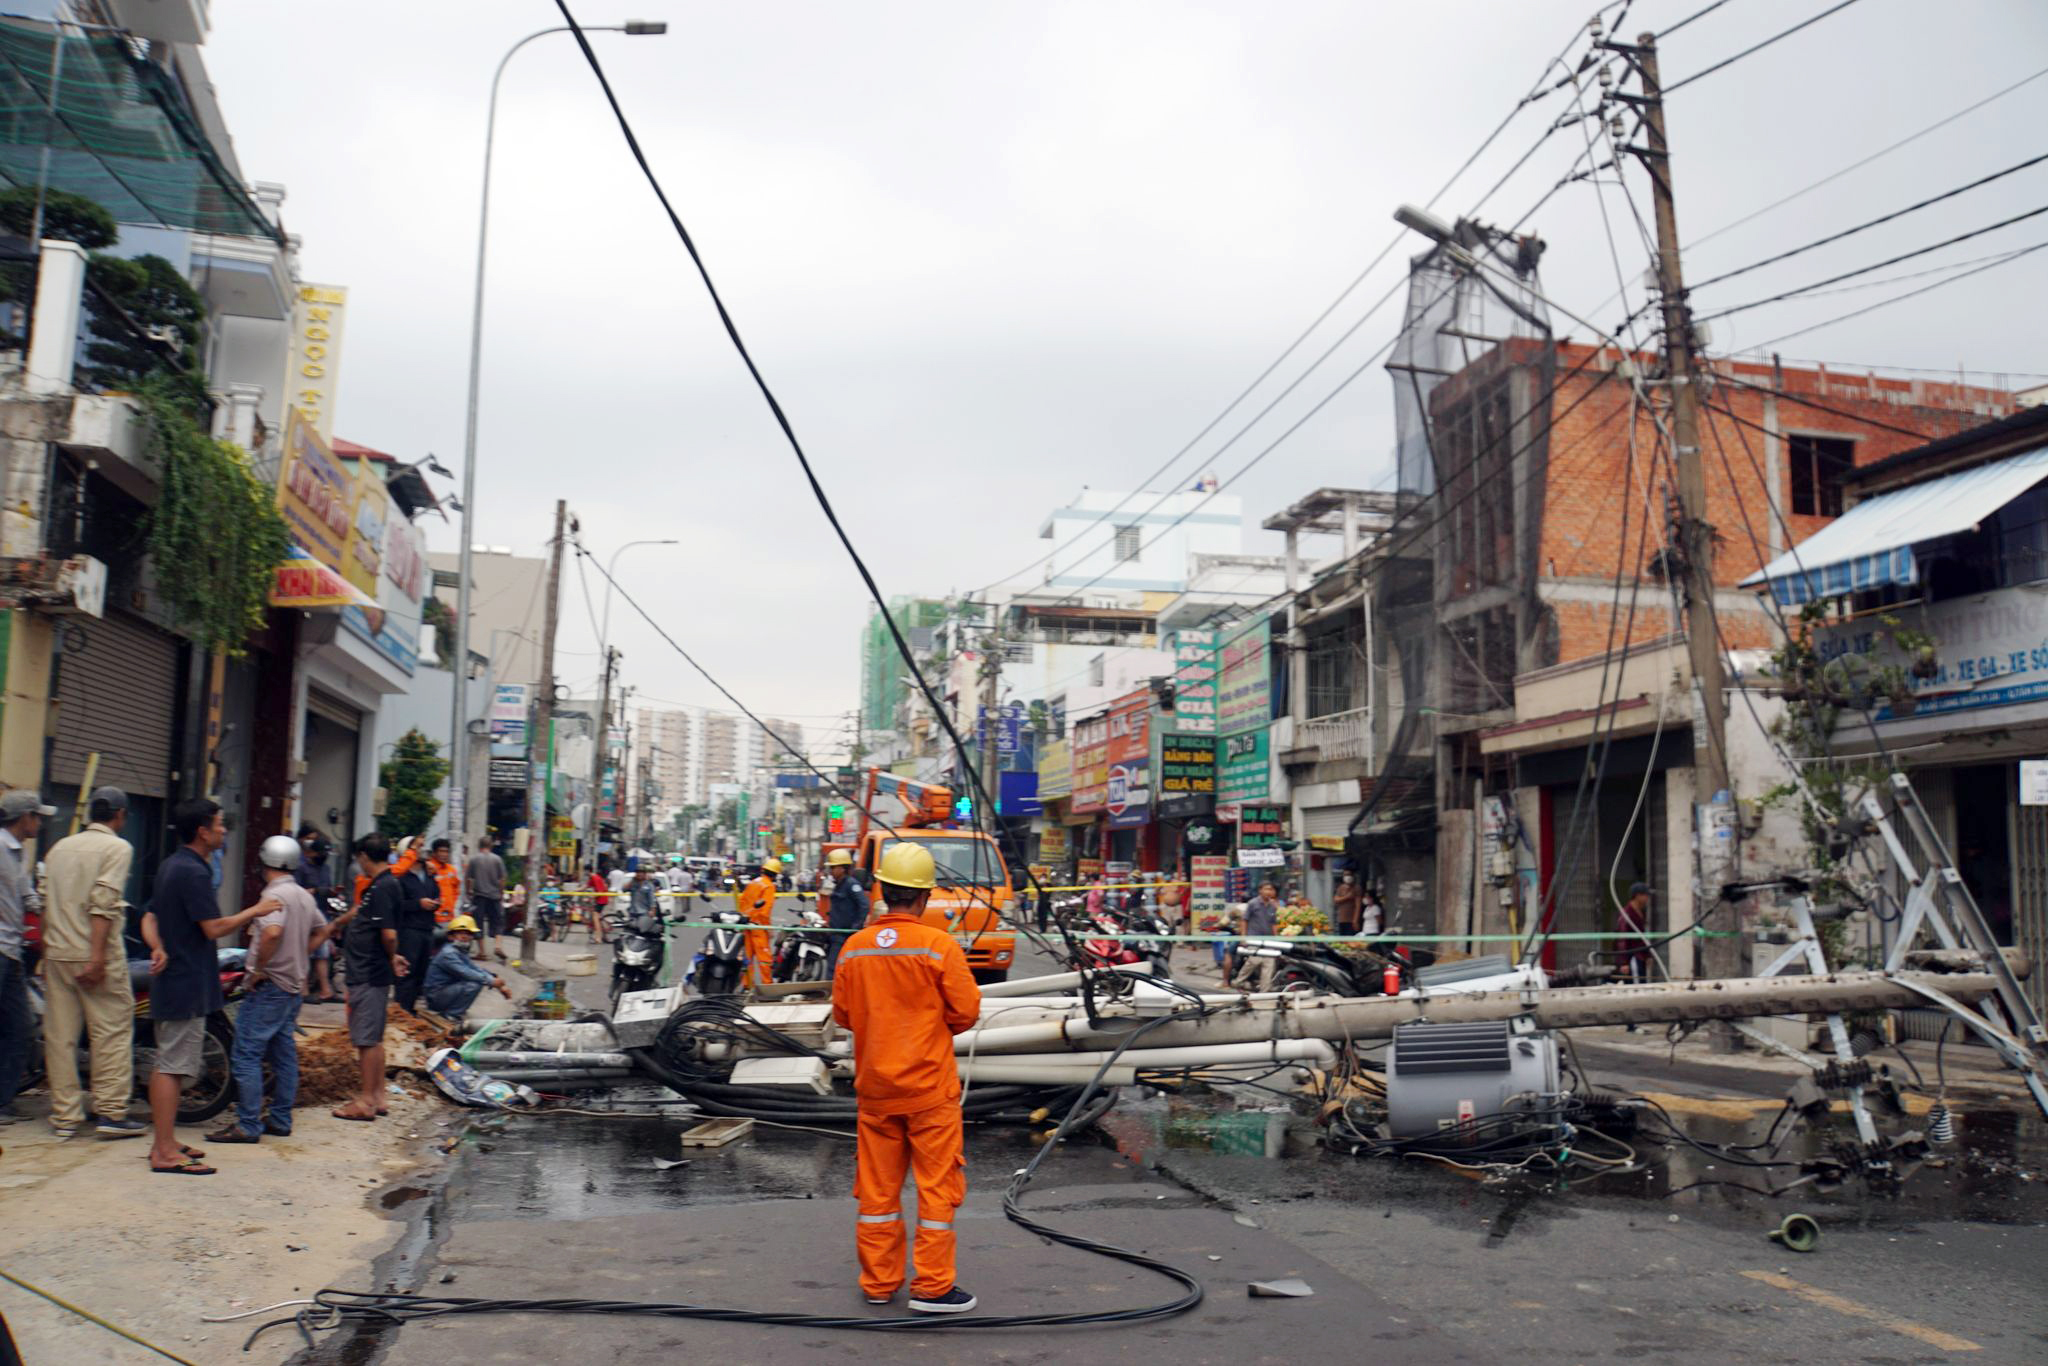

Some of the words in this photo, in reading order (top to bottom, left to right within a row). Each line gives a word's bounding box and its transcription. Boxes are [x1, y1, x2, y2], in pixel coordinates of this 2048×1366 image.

[1178, 630, 1213, 644] IN
[1853, 631, 1873, 654] XE
[1957, 659, 1976, 682] XE
[1980, 655, 1998, 678] GA
[2009, 649, 2028, 673] XE
[1177, 699, 1215, 715] GIÁ
[1164, 777, 1191, 790] GIÁ
